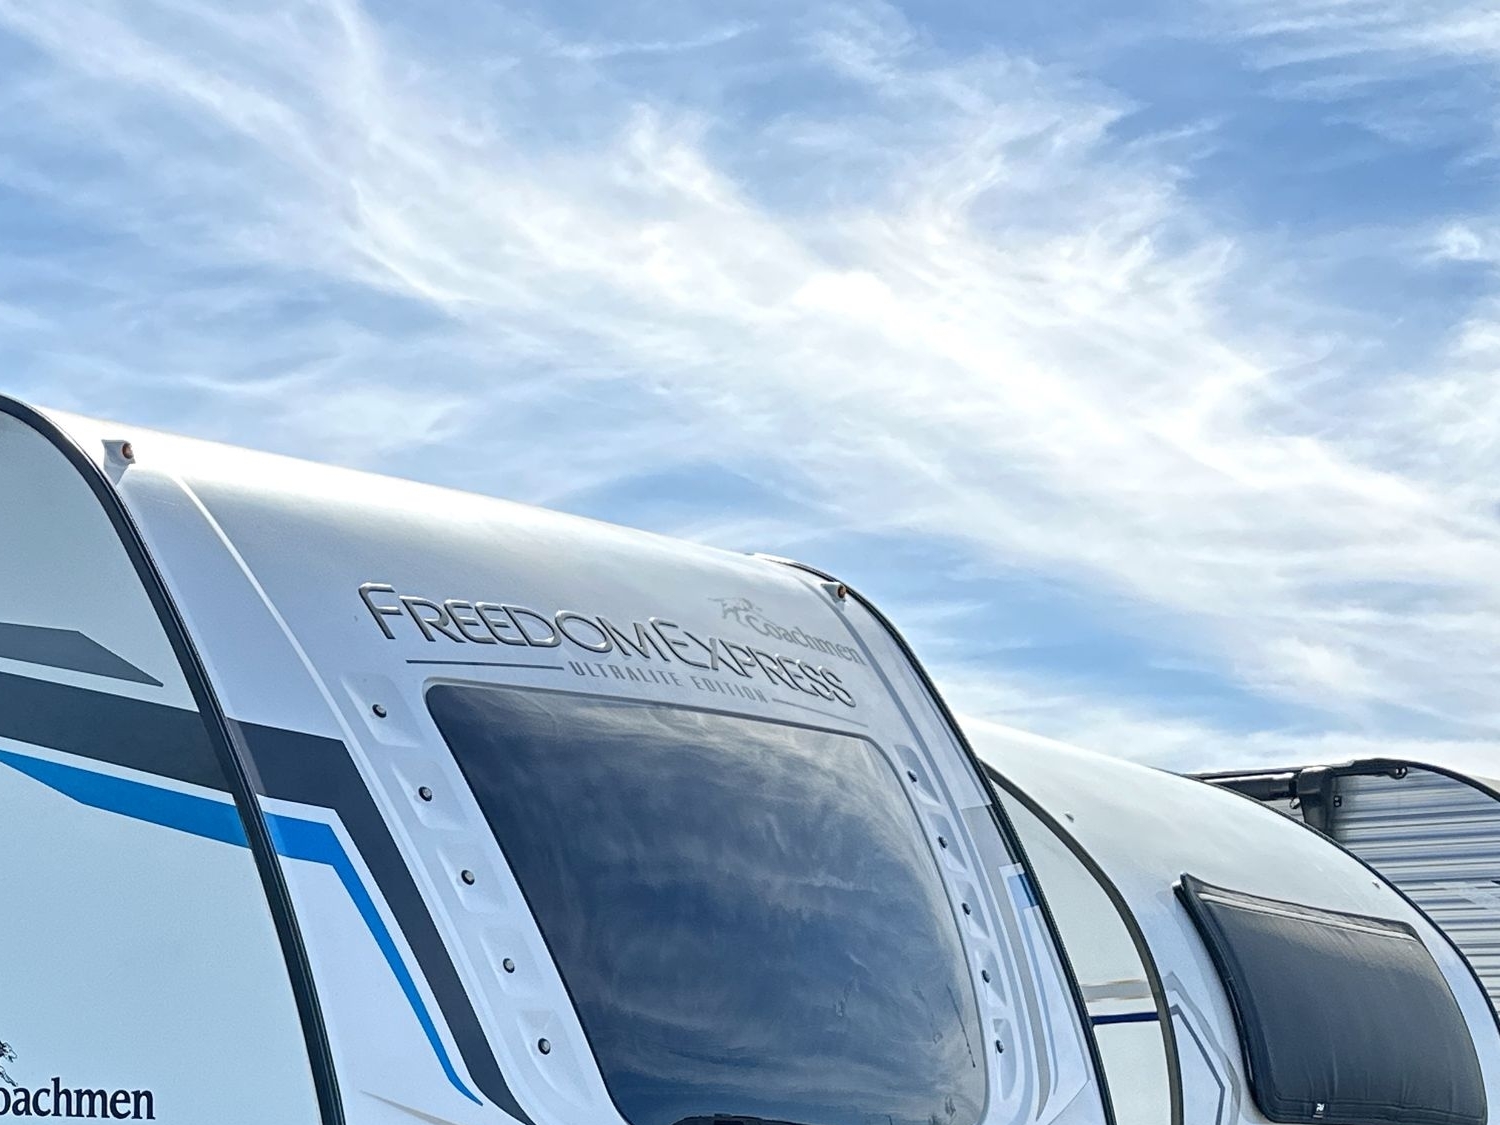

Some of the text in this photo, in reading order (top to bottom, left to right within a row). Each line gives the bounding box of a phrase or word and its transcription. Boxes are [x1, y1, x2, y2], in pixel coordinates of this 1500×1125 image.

[744, 614, 867, 666] Coachmen
[568, 661, 768, 704] ULTRALITE EDITION
